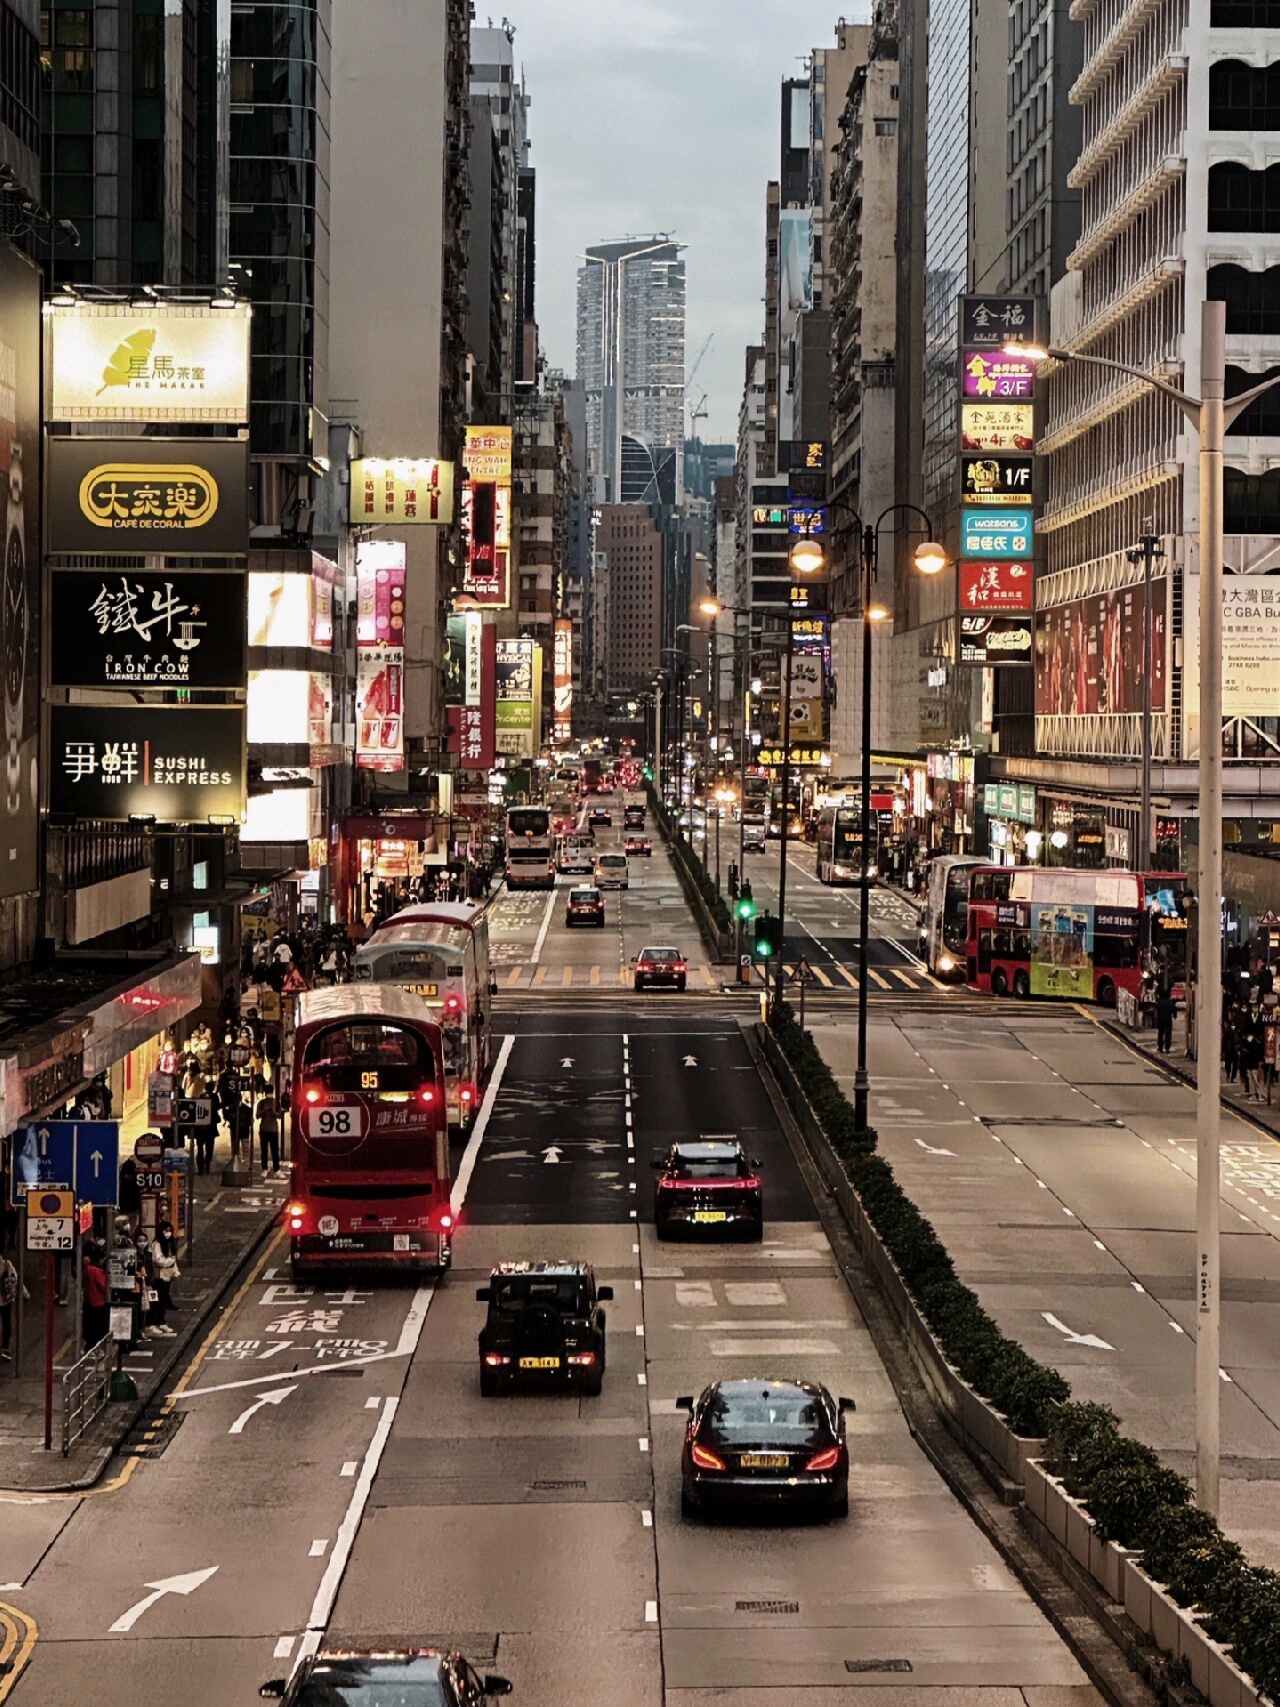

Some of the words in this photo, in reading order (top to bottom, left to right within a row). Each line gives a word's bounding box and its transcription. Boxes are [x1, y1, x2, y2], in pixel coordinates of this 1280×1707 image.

[124, 355, 205, 380] 星馬茶室
[127, 381, 150, 389] THE
[160, 381, 205, 389] MAKAN
[1000, 380, 1028, 396] 3/F
[1005, 467, 1031, 487] 1/F
[113, 518, 138, 528] CAFÉ
[139, 520, 153, 528] DE
[152, 520, 185, 528] CORAL
[974, 518, 1018, 528] watsons
[967, 536, 1008, 551] 屈臣氏
[1235, 606, 1261, 618] GBA
[961, 617, 986, 632] 5/F
[105, 663, 146, 673] IRON
[154, 663, 189, 673] COW
[105, 673, 142, 681] TAIWANESE
[143, 673, 158, 681] BEEF
[159, 673, 190, 681] NOODLES
[466, 707, 482, 759] 隆銀行
[154, 757, 206, 770] SUSHI
[154, 771, 232, 785] EXPRESS
[228, 1080, 248, 1090] S11
[361, 1071, 378, 1088] 95
[319, 1110, 351, 1134] 98
[136, 1173, 162, 1187] S10
[57, 1219, 64, 1230] 7
[57, 1236, 72, 1248] 12
[258, 1284, 374, 1305] 巴士
[255, 1340, 294, 1360] 7
[356, 1339, 389, 1357] 8
